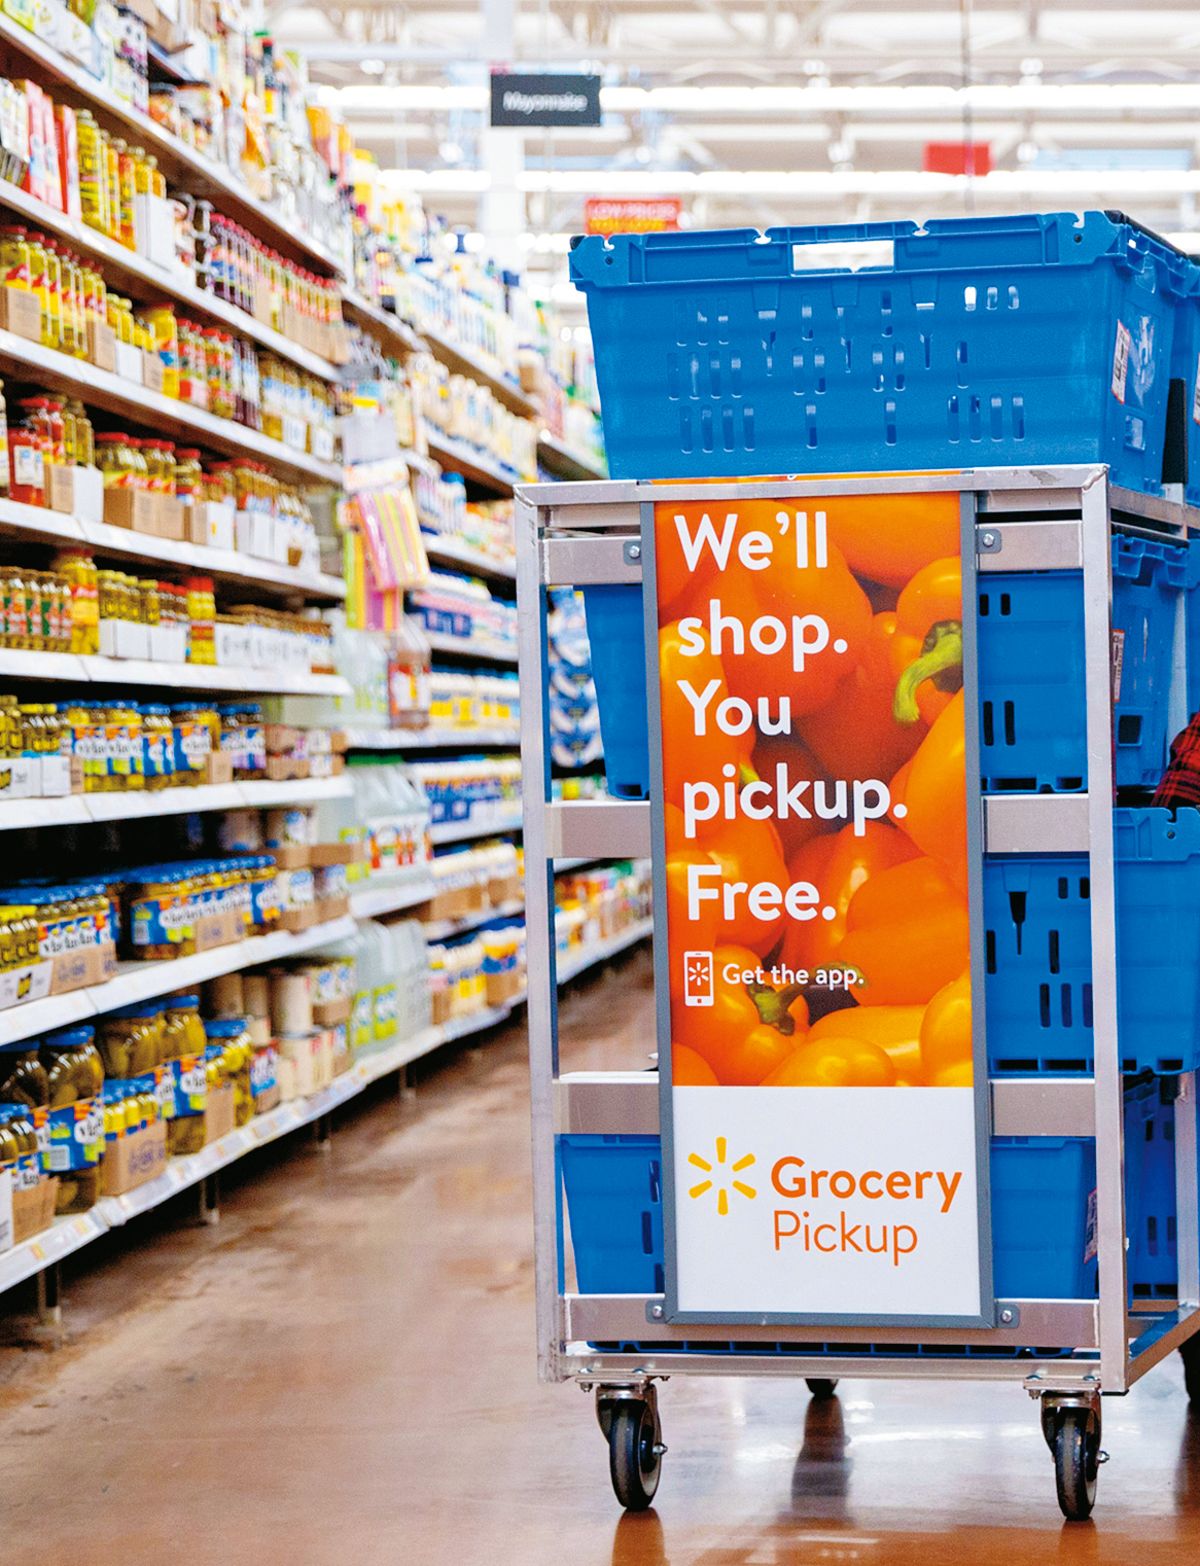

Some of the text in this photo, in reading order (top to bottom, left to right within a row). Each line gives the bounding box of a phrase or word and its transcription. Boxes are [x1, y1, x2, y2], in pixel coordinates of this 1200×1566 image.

[677, 599, 849, 672] shop.
[676, 679, 792, 736] You
[683, 762, 908, 839] pickup.
[686, 865, 837, 921] Free.
[722, 964, 865, 991] Get the app.
[770, 1156, 963, 1213] Grocery
[774, 1210, 919, 1267] Pickup
